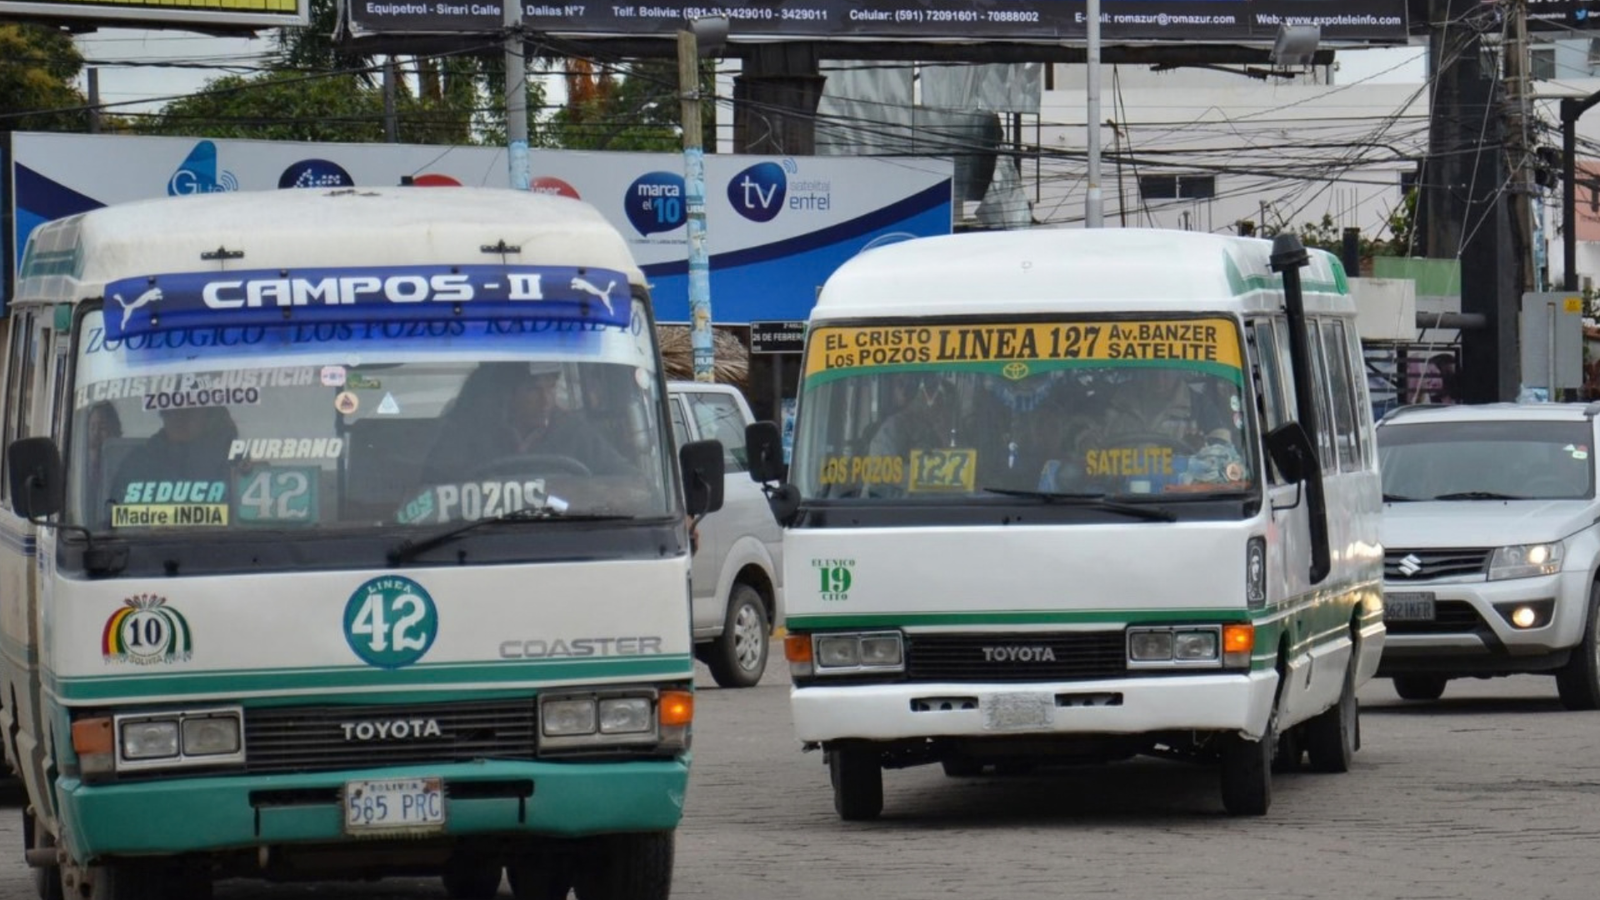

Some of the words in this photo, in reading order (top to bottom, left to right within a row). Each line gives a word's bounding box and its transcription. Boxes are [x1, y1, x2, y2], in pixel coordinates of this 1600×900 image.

[366, 2, 427, 16] Equipetrol
[437, 4, 468, 15] Sirari
[471, 5, 500, 16] Calle
[526, 5, 562, 16] Dalias
[612, 7, 636, 17] Telf.
[639, 7, 680, 18] Bolivia:
[725, 8, 772, 19] 3429010
[782, 9, 828, 20] 3429011
[849, 10, 893, 21] Celular:
[895, 10, 923, 22] (591)
[926, 11, 978, 22] 72091601
[987, 11, 1039, 22] 70888002
[1075, 12, 1111, 23] E-il:
[1114, 13, 1236, 26] romazur@romazur.com
[1256, 14, 1283, 24] Web:
[1285, 14, 1401, 27] www.expoteleinfo.com
[638, 183, 680, 197] marca
[740, 175, 777, 209] tv
[790, 180, 831, 191] satelital
[642, 198, 652, 211] el
[653, 197, 680, 223] 10
[789, 193, 831, 210] entel
[85, 324, 266, 354] ZOOLOGICO
[294, 318, 353, 342] LOS
[762, 333, 772, 341] DE
[826, 334, 848, 351] EL
[855, 328, 931, 347] CRISTO
[937, 328, 1039, 361] LINEA
[1048, 326, 1101, 359] 127
[859, 346, 931, 365] POZOS
[1108, 342, 1217, 361] SATELITE
[94, 374, 179, 400] CRISTO
[213, 366, 315, 388] JUSTICIA
[145, 388, 259, 409] ZOOLOGICO
[228, 438, 343, 460] P/URBANO
[820, 457, 847, 484] LOS
[852, 456, 903, 484] POZOS
[917, 451, 969, 486] 127
[1086, 448, 1173, 475] SATELITE
[124, 481, 226, 503] SEDUCA
[241, 471, 309, 519] 42
[436, 479, 545, 523] POZOS
[115, 506, 168, 525] Madre
[174, 506, 222, 524] INDIA
[367, 580, 412, 594] LINEA
[818, 567, 852, 592] 19
[129, 617, 162, 646] 10
[351, 593, 427, 651] 42
[500, 636, 662, 658] COASTER
[982, 646, 1056, 661] TOYOTA
[341, 719, 441, 740] TOYOTA
[369, 782, 418, 791] BOLIVIA
[349, 795, 388, 821] 585
[402, 792, 440, 820] PRC
